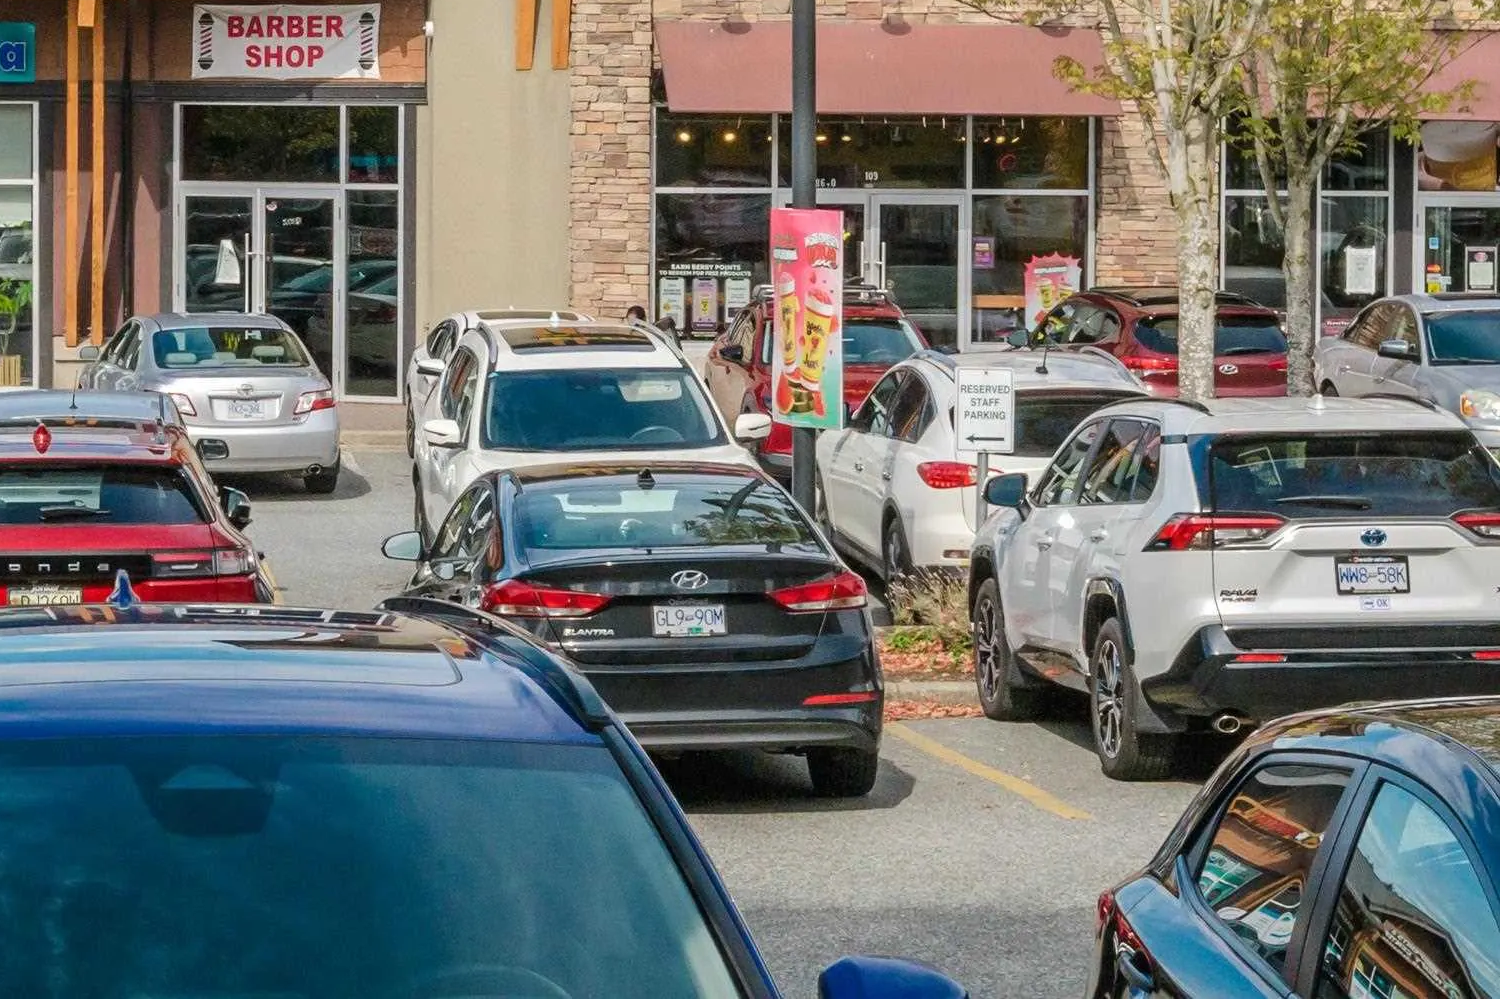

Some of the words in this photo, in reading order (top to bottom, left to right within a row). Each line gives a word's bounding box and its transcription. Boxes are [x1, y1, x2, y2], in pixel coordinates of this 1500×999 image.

[227, 15, 344, 39] BARBER
[245, 45, 324, 68] SHOP
[864, 171, 879, 181] 109
[714, 263, 741, 271] POINTS
[960, 384, 1011, 394] RESERVED
[970, 397, 1001, 407] STAFF
[964, 410, 1006, 420] PARKING
[1339, 566, 1406, 584] WW8-58K
[656, 608, 724, 626] GL9-90M
[562, 628, 616, 637] ELANTRA
